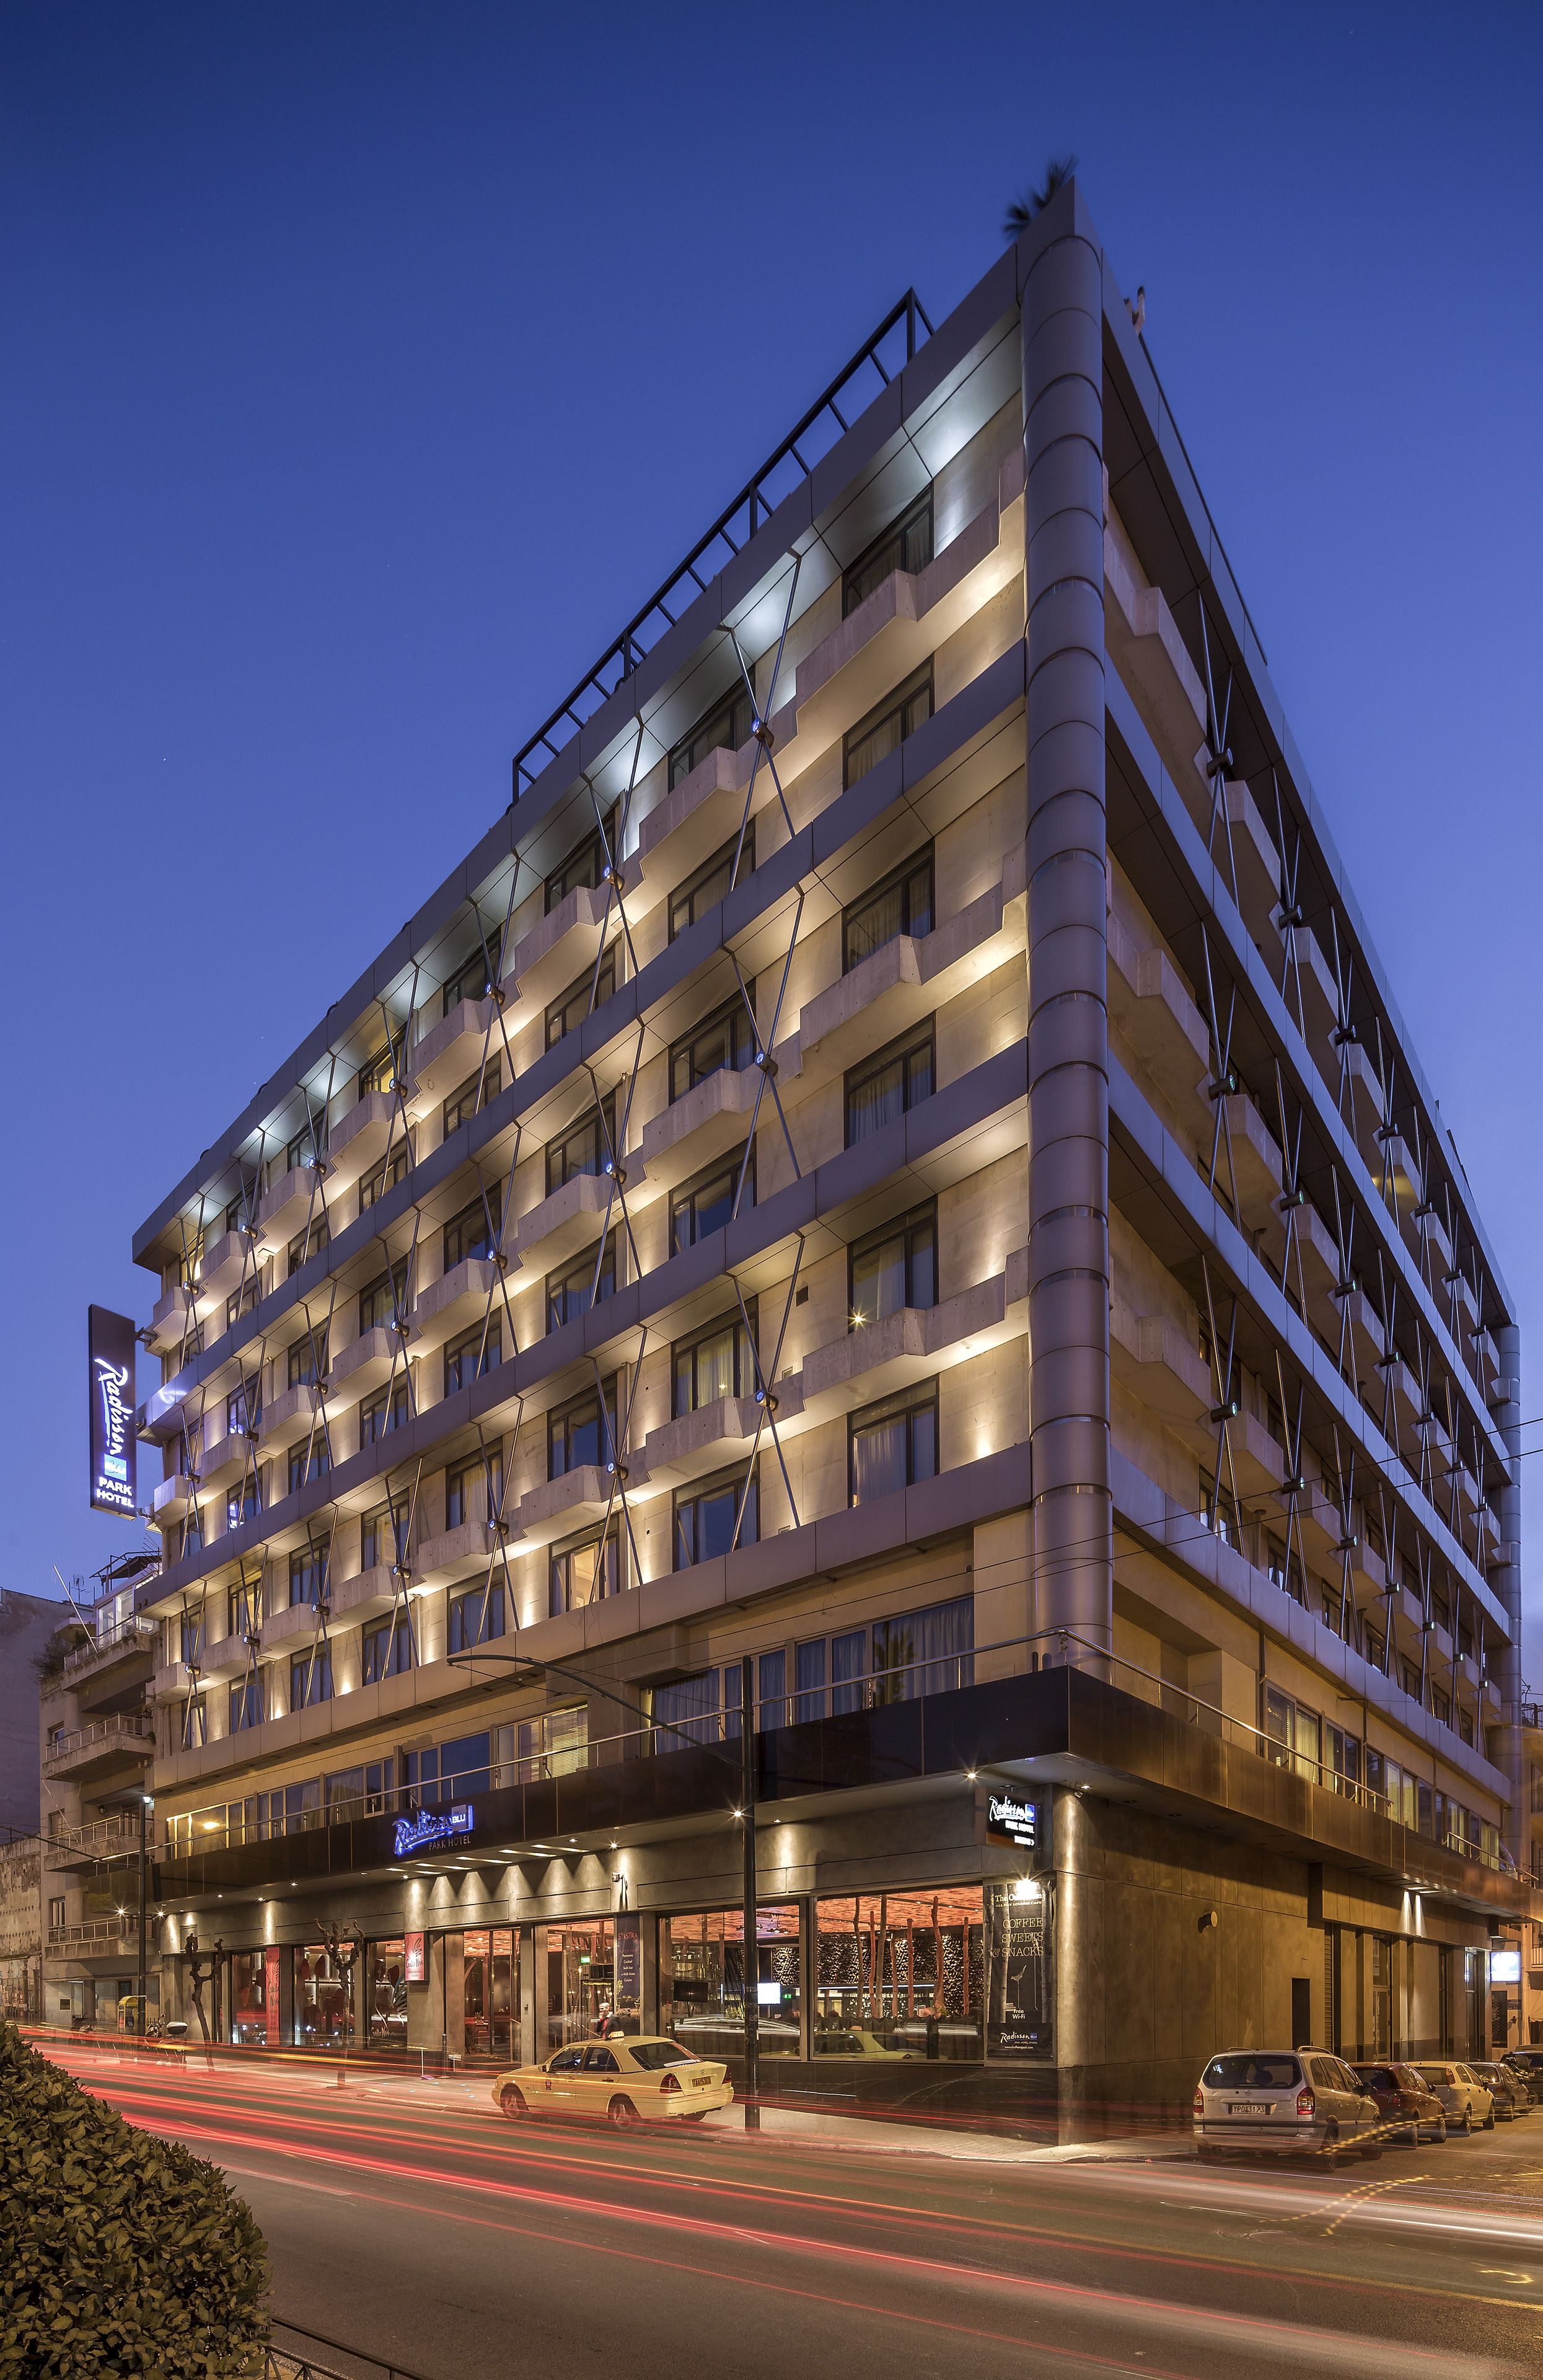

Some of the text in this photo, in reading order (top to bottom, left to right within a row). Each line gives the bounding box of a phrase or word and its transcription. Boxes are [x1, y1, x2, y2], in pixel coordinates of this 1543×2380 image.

[94, 1358, 133, 1456] Radisson
[99, 1476, 133, 1496] PARK
[96, 1488, 134, 1508] HOTEL
[989, 1796, 1025, 1822] Radisson
[392, 1810, 466, 1855] Radisson BLU
[429, 1835, 471, 1851] PARK HOTEL
[994, 1894, 1008, 1902] The
[1003, 1918, 1043, 1929] COFFEE
[1001, 1932, 1044, 1943] SWEETS
[992, 1946, 1044, 1958] & SNACKS
[1000, 2031, 1030, 2044] Radisson
